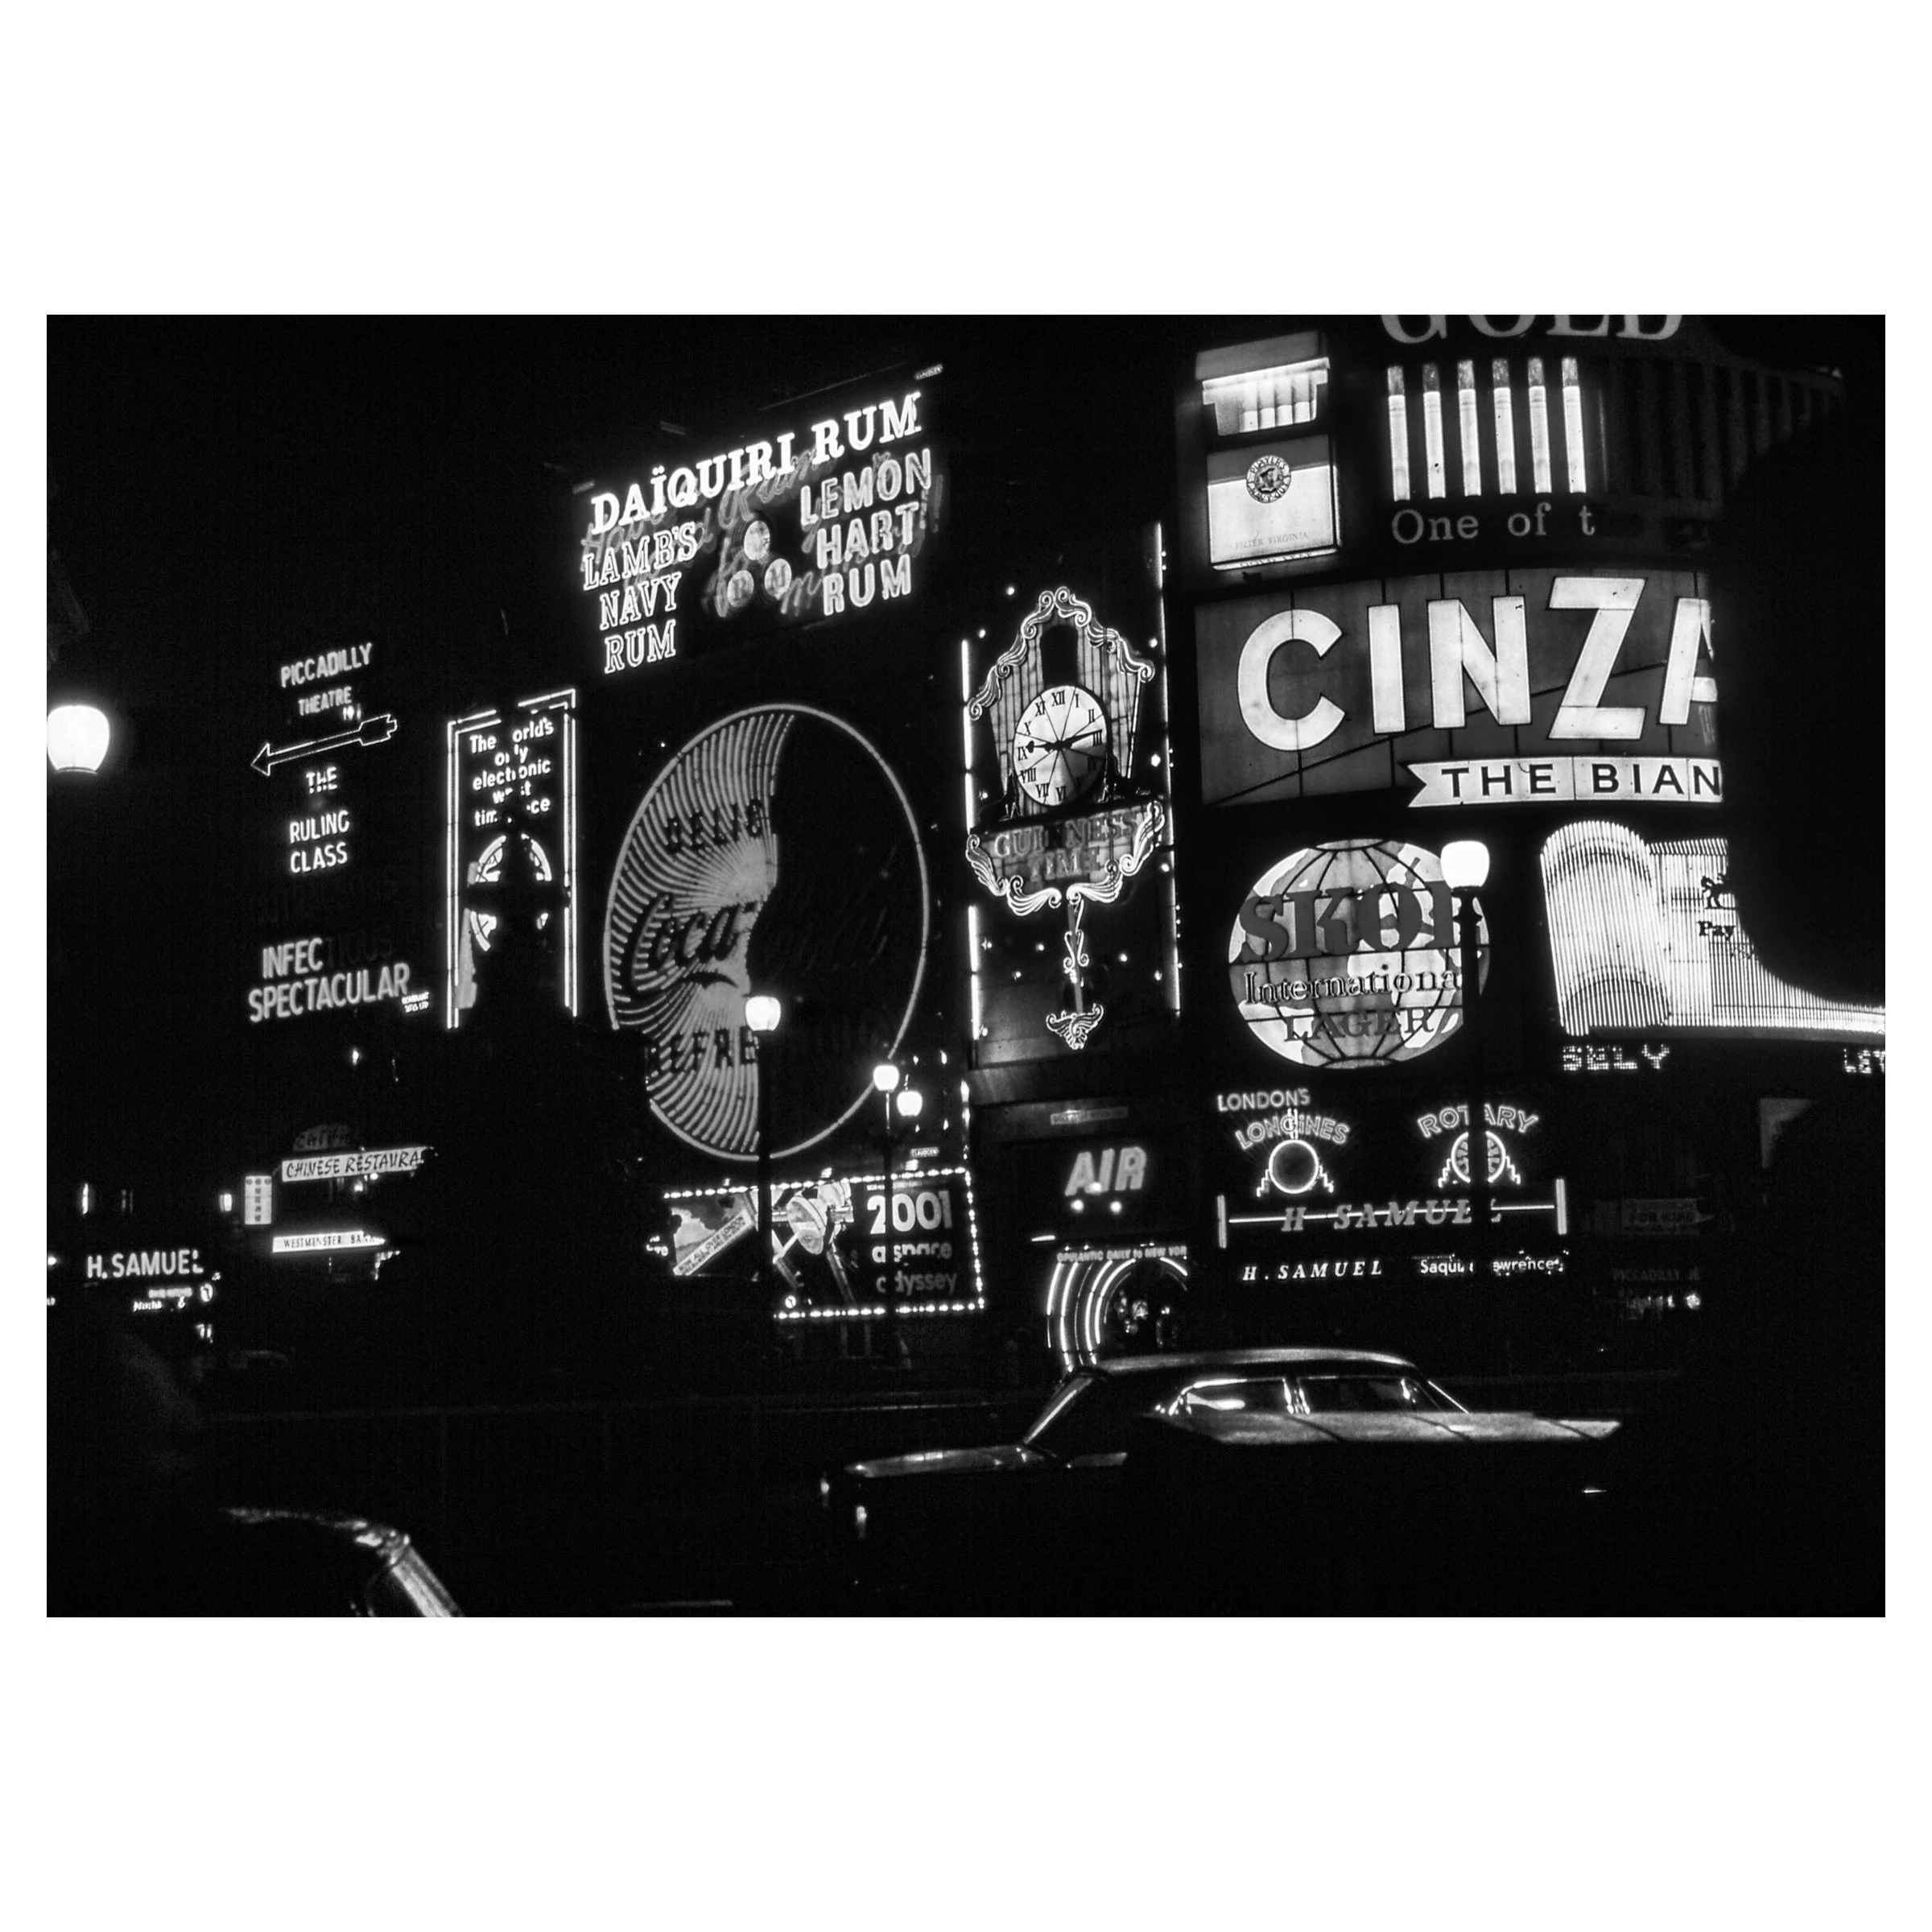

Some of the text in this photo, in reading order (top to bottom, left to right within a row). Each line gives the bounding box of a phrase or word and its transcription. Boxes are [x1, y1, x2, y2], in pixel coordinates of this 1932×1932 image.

[811, 390, 922, 465] RUM
[800, 448, 932, 526] LEMON
[816, 502, 920, 569] HART
[1391, 510, 1478, 544] One
[1508, 503, 1551, 536] of
[823, 553, 912, 616] RUM
[600, 572, 683, 630] NAVY
[604, 620, 677, 675] RUM
[280, 643, 372, 687] PICCADILLY
[299, 686, 353, 716] THEATRE
[1035, 700, 1045, 717] XI
[1051, 690, 1066, 708] XII
[1088, 708, 1095, 724] II
[469, 716, 555, 753] The orld's
[1018, 745, 1028, 762] IX
[306, 766, 337, 795] THE
[1020, 767, 1037, 784] VIII
[1035, 781, 1051, 799] VII
[1441, 764, 1720, 798] THE BIAN
[289, 811, 350, 844] RULING
[994, 814, 1136, 858] GUINNESS
[290, 842, 348, 874] CLASS
[1030, 846, 1100, 881] TIME
[1697, 920, 1736, 941] Pay
[248, 962, 411, 1023] SPECTACULAR
[1245, 963, 1460, 1005] Internationa
[1283, 1008, 1435, 1042] LAGER
[1216, 1088, 1311, 1113] LONDON'S
[286, 1150, 422, 1178] CHINESE RESTAURA
[1064, 1146, 1147, 1196] AIR
[867, 1189, 953, 1235] 2001
[1281, 1207, 1307, 1232] H
[283, 1235, 342, 1249] WESTMINSTER
[871, 1245, 886, 1264] a
[1106, 1249, 1132, 1261] DAILY
[1144, 1246, 1166, 1259] NEW
[111, 1247, 204, 1278] SAMUEL
[1278, 1261, 1383, 1281] SAMUEL
[1492, 1258, 1556, 1274] awrence
